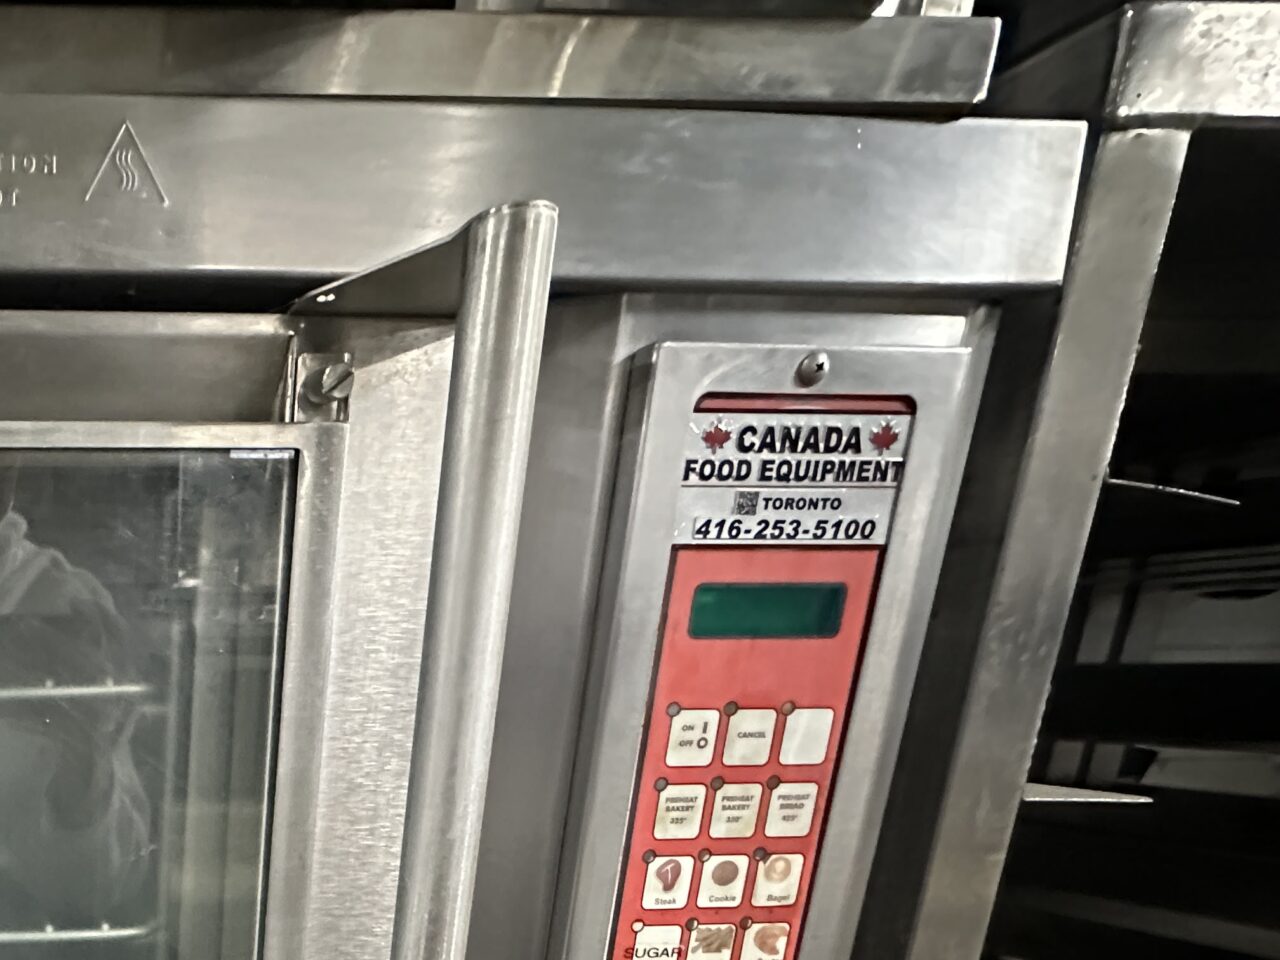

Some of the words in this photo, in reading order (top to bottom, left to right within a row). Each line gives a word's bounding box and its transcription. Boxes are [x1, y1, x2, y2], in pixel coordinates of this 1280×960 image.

[736, 426, 861, 453] CANADA
[682, 459, 751, 481] FOOD
[757, 460, 904, 483] EQUIPMENT
[762, 497, 841, 510] TORONTO
[694, 518, 875, 540] 416-253-5100
[737, 731, 766, 739] CANCEL
[654, 898, 676, 906] Steak
[708, 895, 736, 903] Cookie
[766, 894, 790, 904] Bagel
[624, 947, 682, 959] SUGAR
